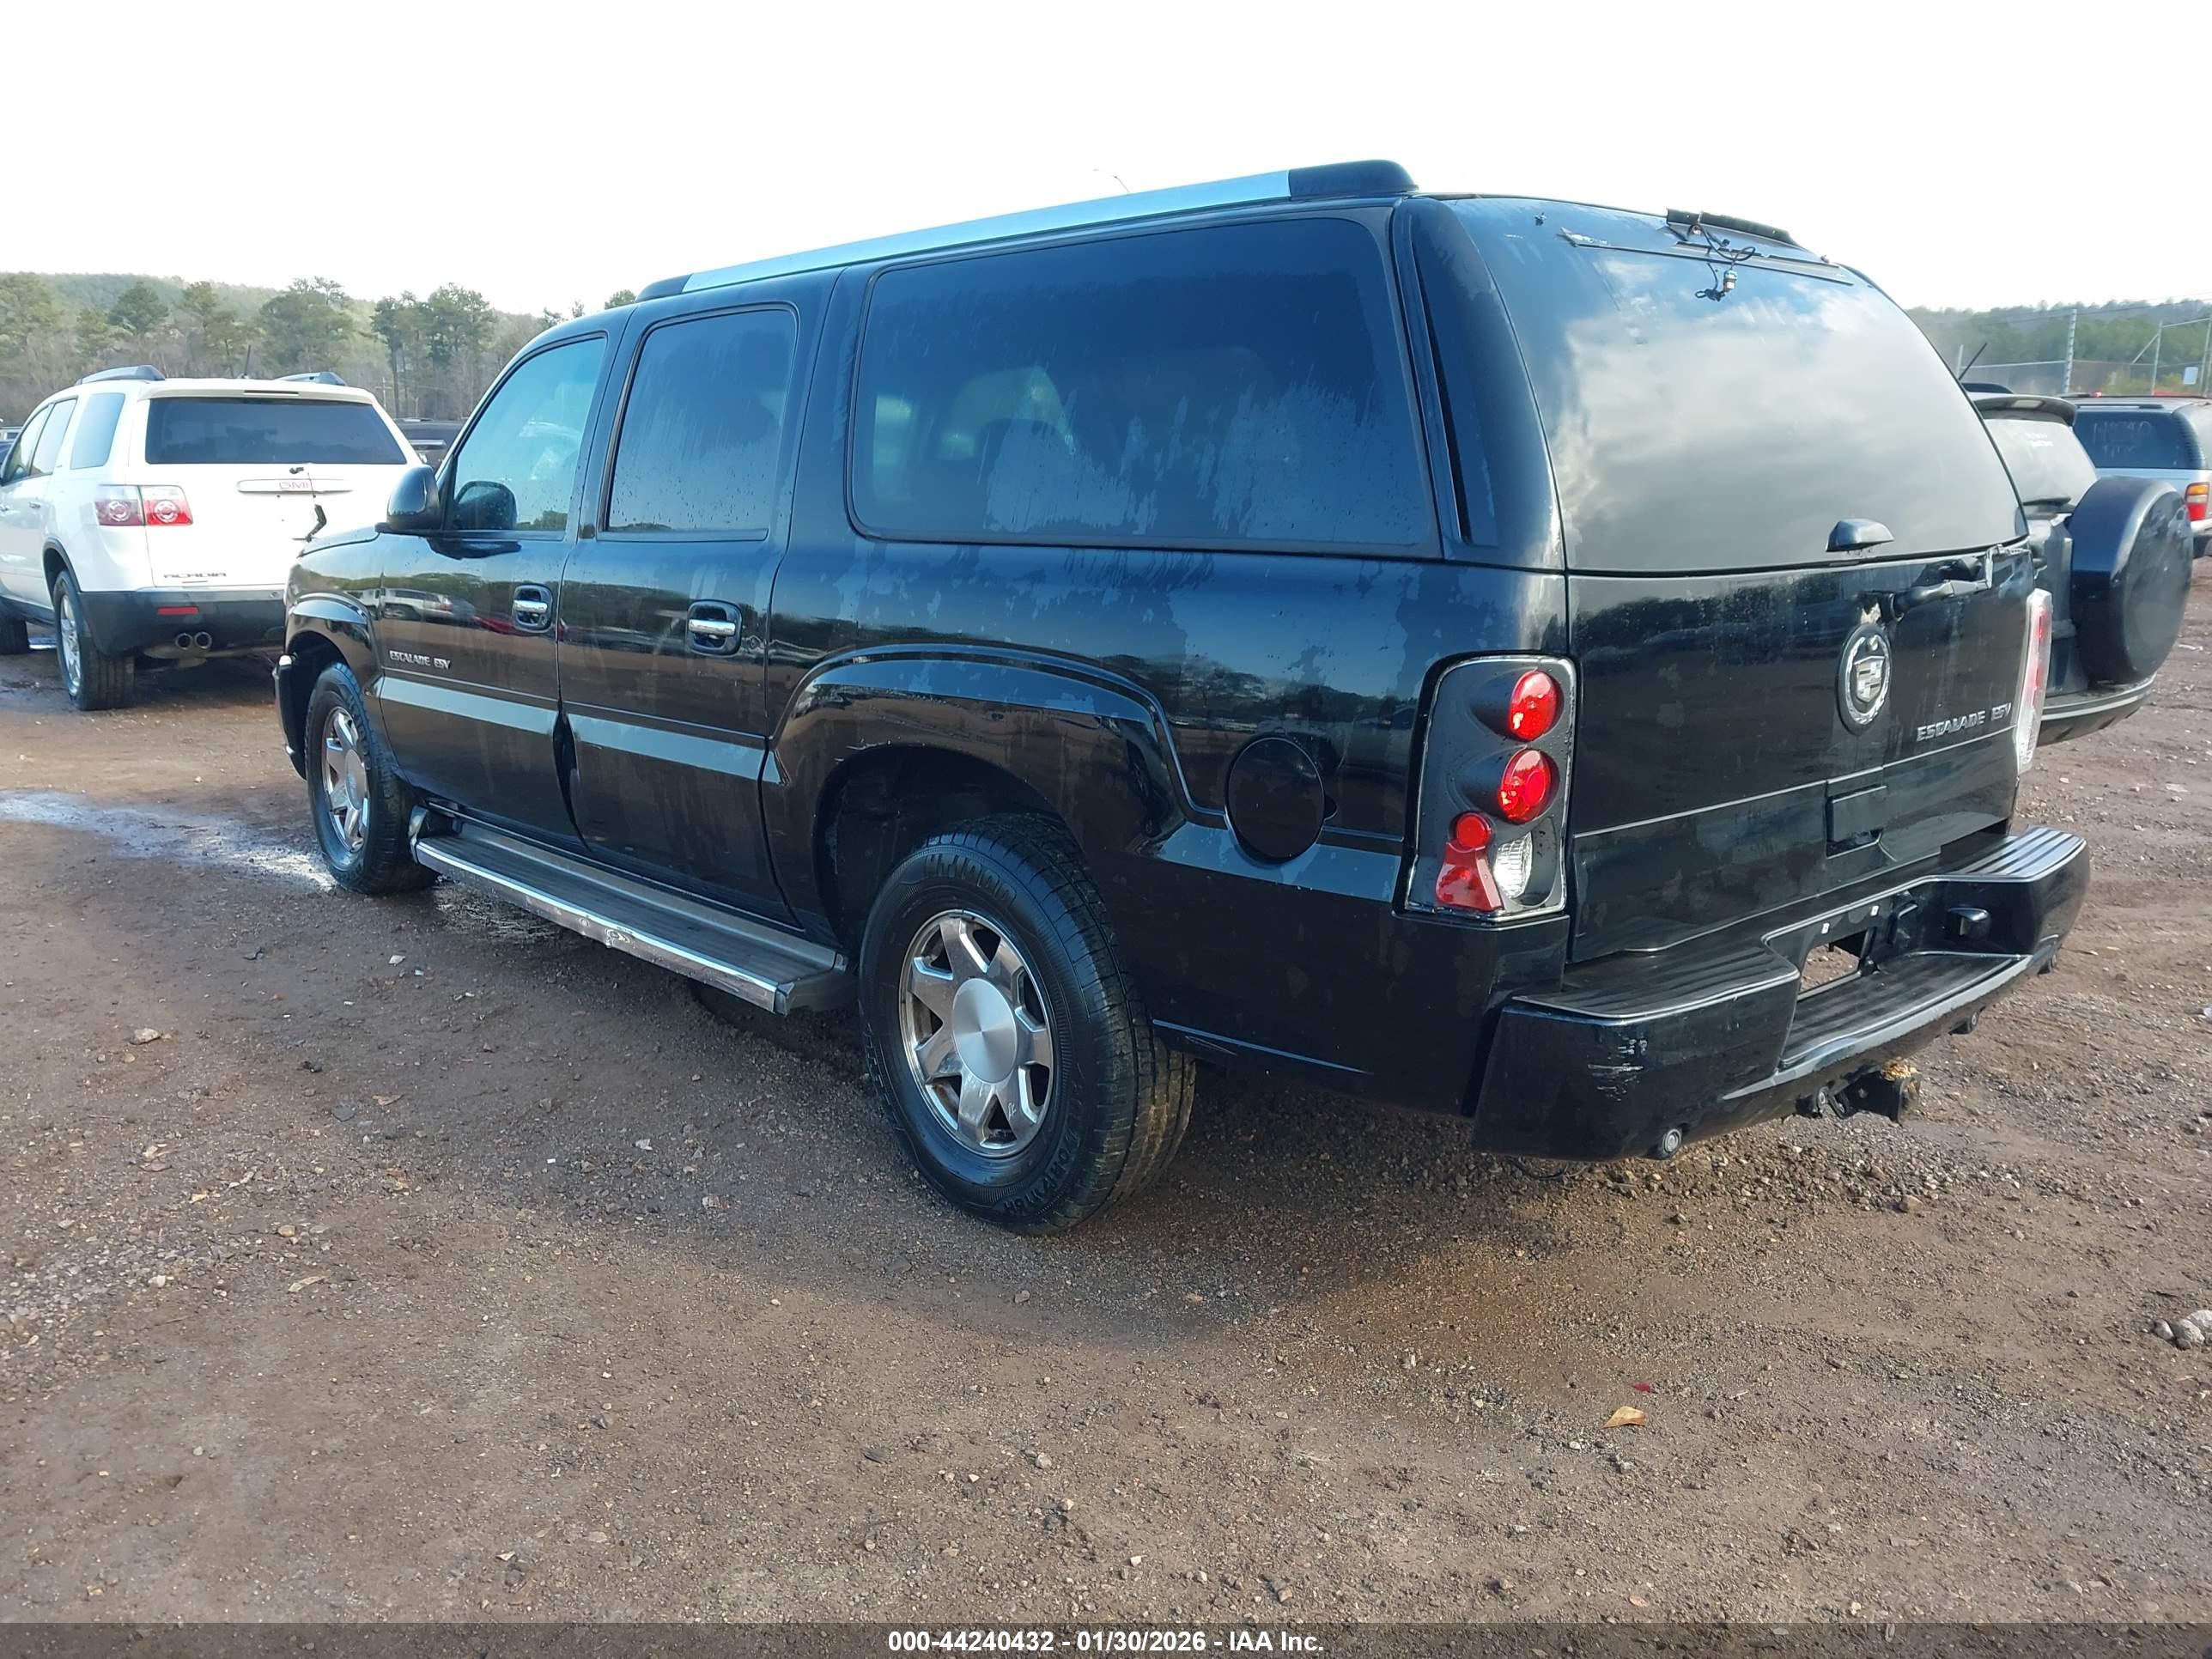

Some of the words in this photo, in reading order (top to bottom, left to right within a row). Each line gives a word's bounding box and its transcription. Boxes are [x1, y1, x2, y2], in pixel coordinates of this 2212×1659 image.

[389, 650, 431, 666] ESCALADE
[434, 657, 451, 669] ESV
[1917, 710, 1985, 742] ESCALADE
[1991, 702, 2012, 721] ESV
